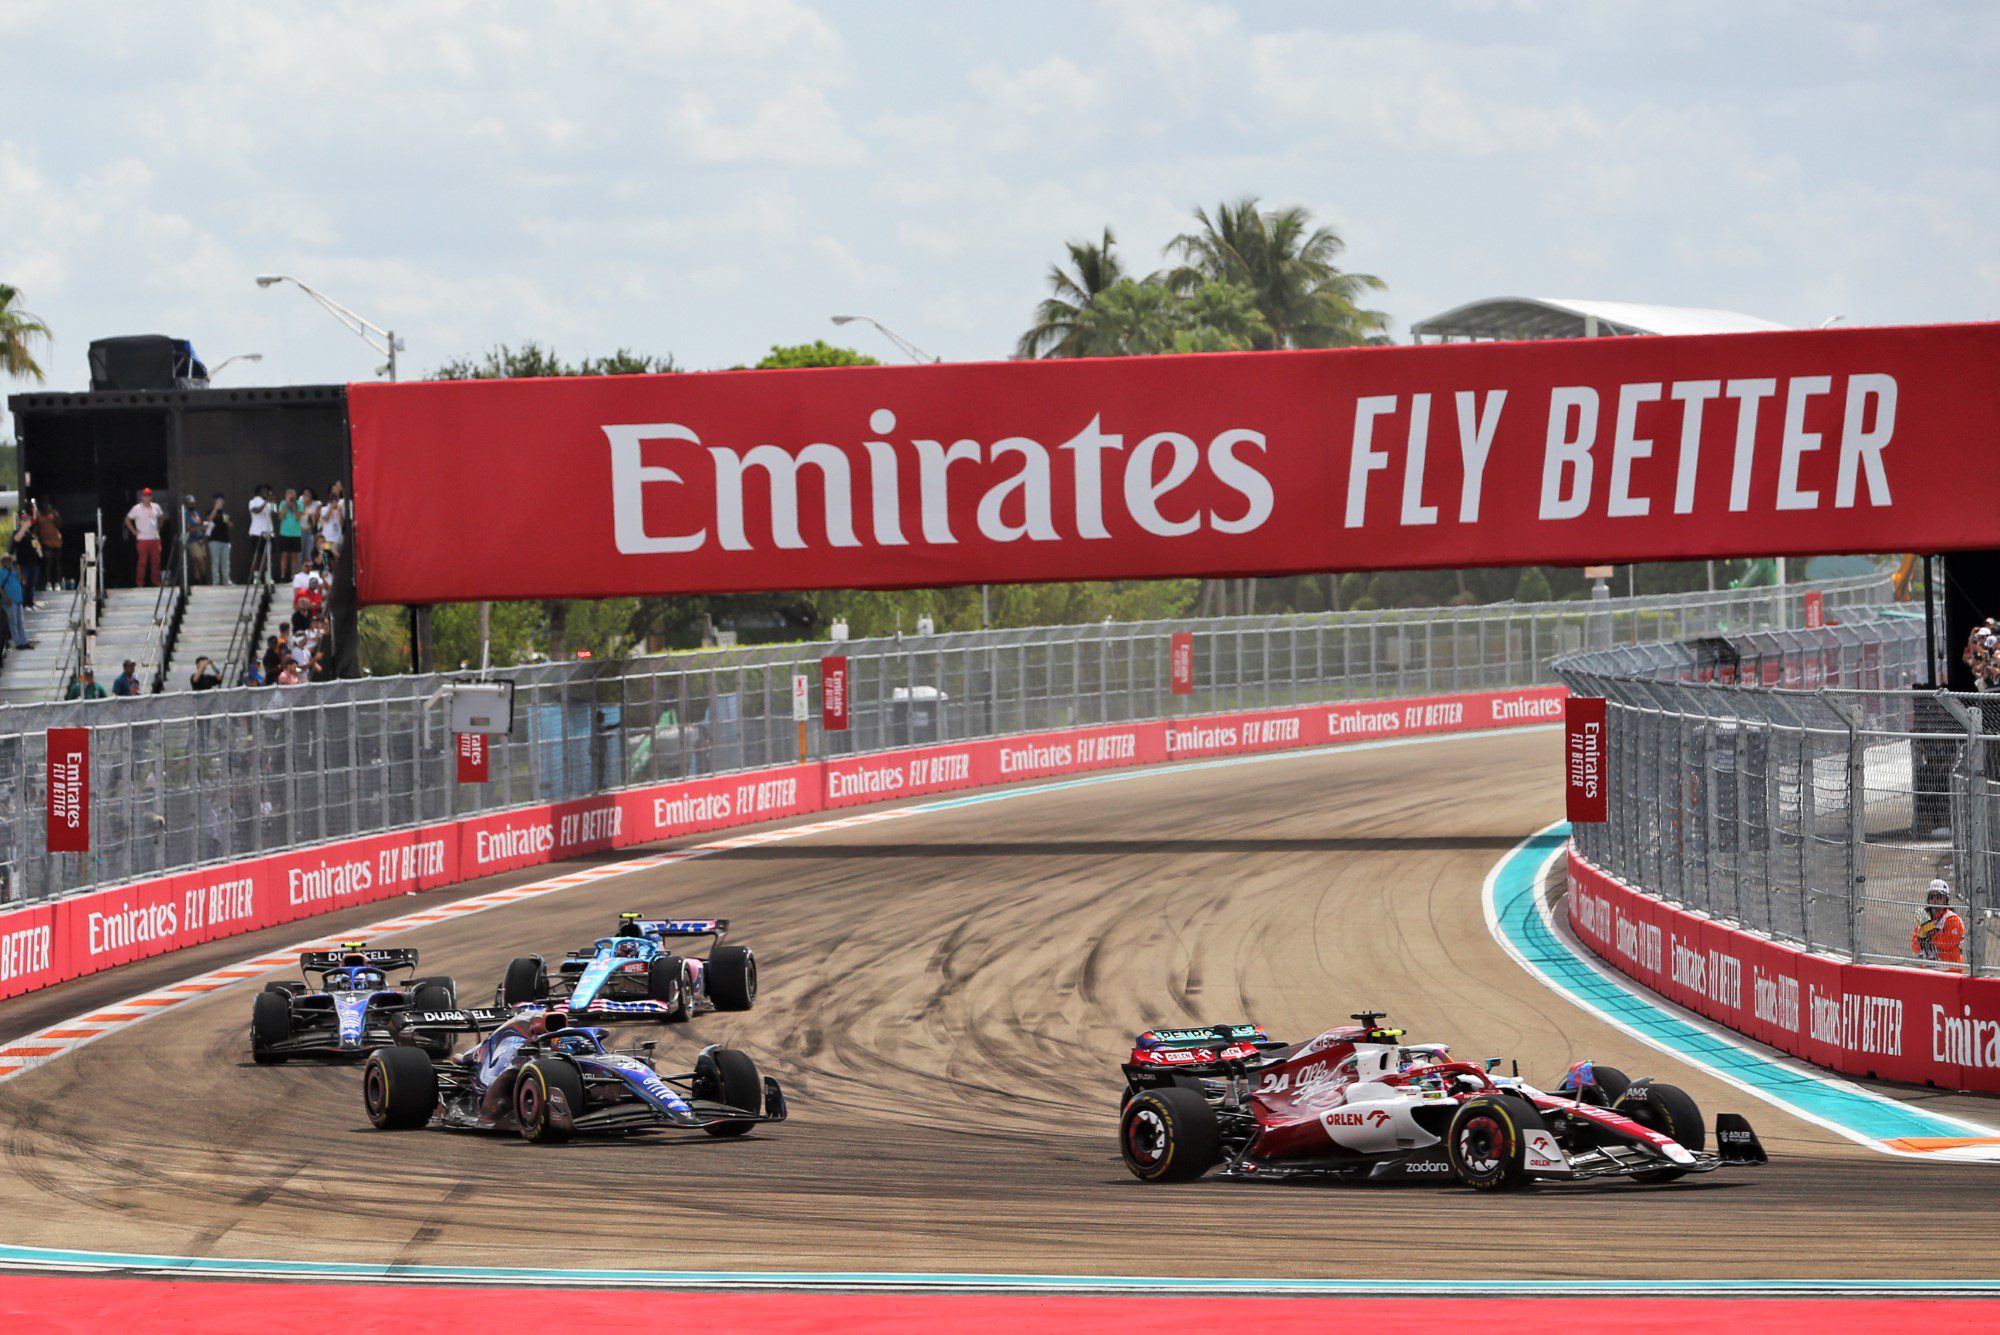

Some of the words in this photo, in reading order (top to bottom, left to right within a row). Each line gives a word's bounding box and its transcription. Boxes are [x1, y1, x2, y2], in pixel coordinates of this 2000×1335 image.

[600, 408, 1274, 554] Emirates
[1344, 389, 1508, 528] FLY
[1538, 373, 1898, 520] BETTER
[1328, 710, 1399, 735] Emirates
[1405, 704, 1424, 728] FLY
[1424, 702, 1463, 727] BETTER
[1492, 697, 1562, 720] Emirates
[471, 734, 482, 766] rates
[1165, 725, 1237, 752] Emirates
[1242, 722, 1261, 745] FLY
[1262, 718, 1300, 743] BETTER
[1571, 733, 1584, 750] FLY
[1000, 743, 1072, 773] Emirates
[1077, 738, 1096, 763] FLY
[1096, 733, 1135, 761] BETTER
[1571, 752, 1584, 787] BETTER
[1585, 722, 1600, 799] Emirates
[53, 763, 66, 780] FLY
[829, 766, 903, 798] Emirates
[909, 758, 930, 787] FLY
[930, 753, 969, 784] BETTER
[53, 782, 66, 818] BETTER
[66, 752, 82, 828] Emirates
[653, 792, 731, 827] Emirates
[736, 783, 756, 815] FLY
[757, 777, 797, 811] BETTER
[476, 823, 554, 864] Emirates
[560, 814, 580, 847] FLY
[582, 806, 623, 842] BETTER
[288, 859, 372, 906] Emirates
[378, 848, 399, 886] FLY
[401, 839, 444, 881] BETTER
[88, 901, 177, 956] Emirates
[184, 888, 207, 931] FLY
[208, 877, 253, 926] BETTER
[1, 925, 49, 981] BETTER
[424, 1010, 496, 1022] DURAELL
[1809, 983, 1840, 1047] Emirates
[1842, 993, 1861, 1051] FLY
[1863, 995, 1902, 1056] BETTER
[1167, 1053, 1192, 1061] ORLEN
[1254, 1073, 1290, 1093] 24
[1626, 1087, 1649, 1097] AMX
[1326, 1113, 1363, 1126] ORLEN
[1728, 1131, 1751, 1139] ADLER
[1405, 1160, 1449, 1173] zadara
[1529, 1159, 1550, 1167] ORLEN
